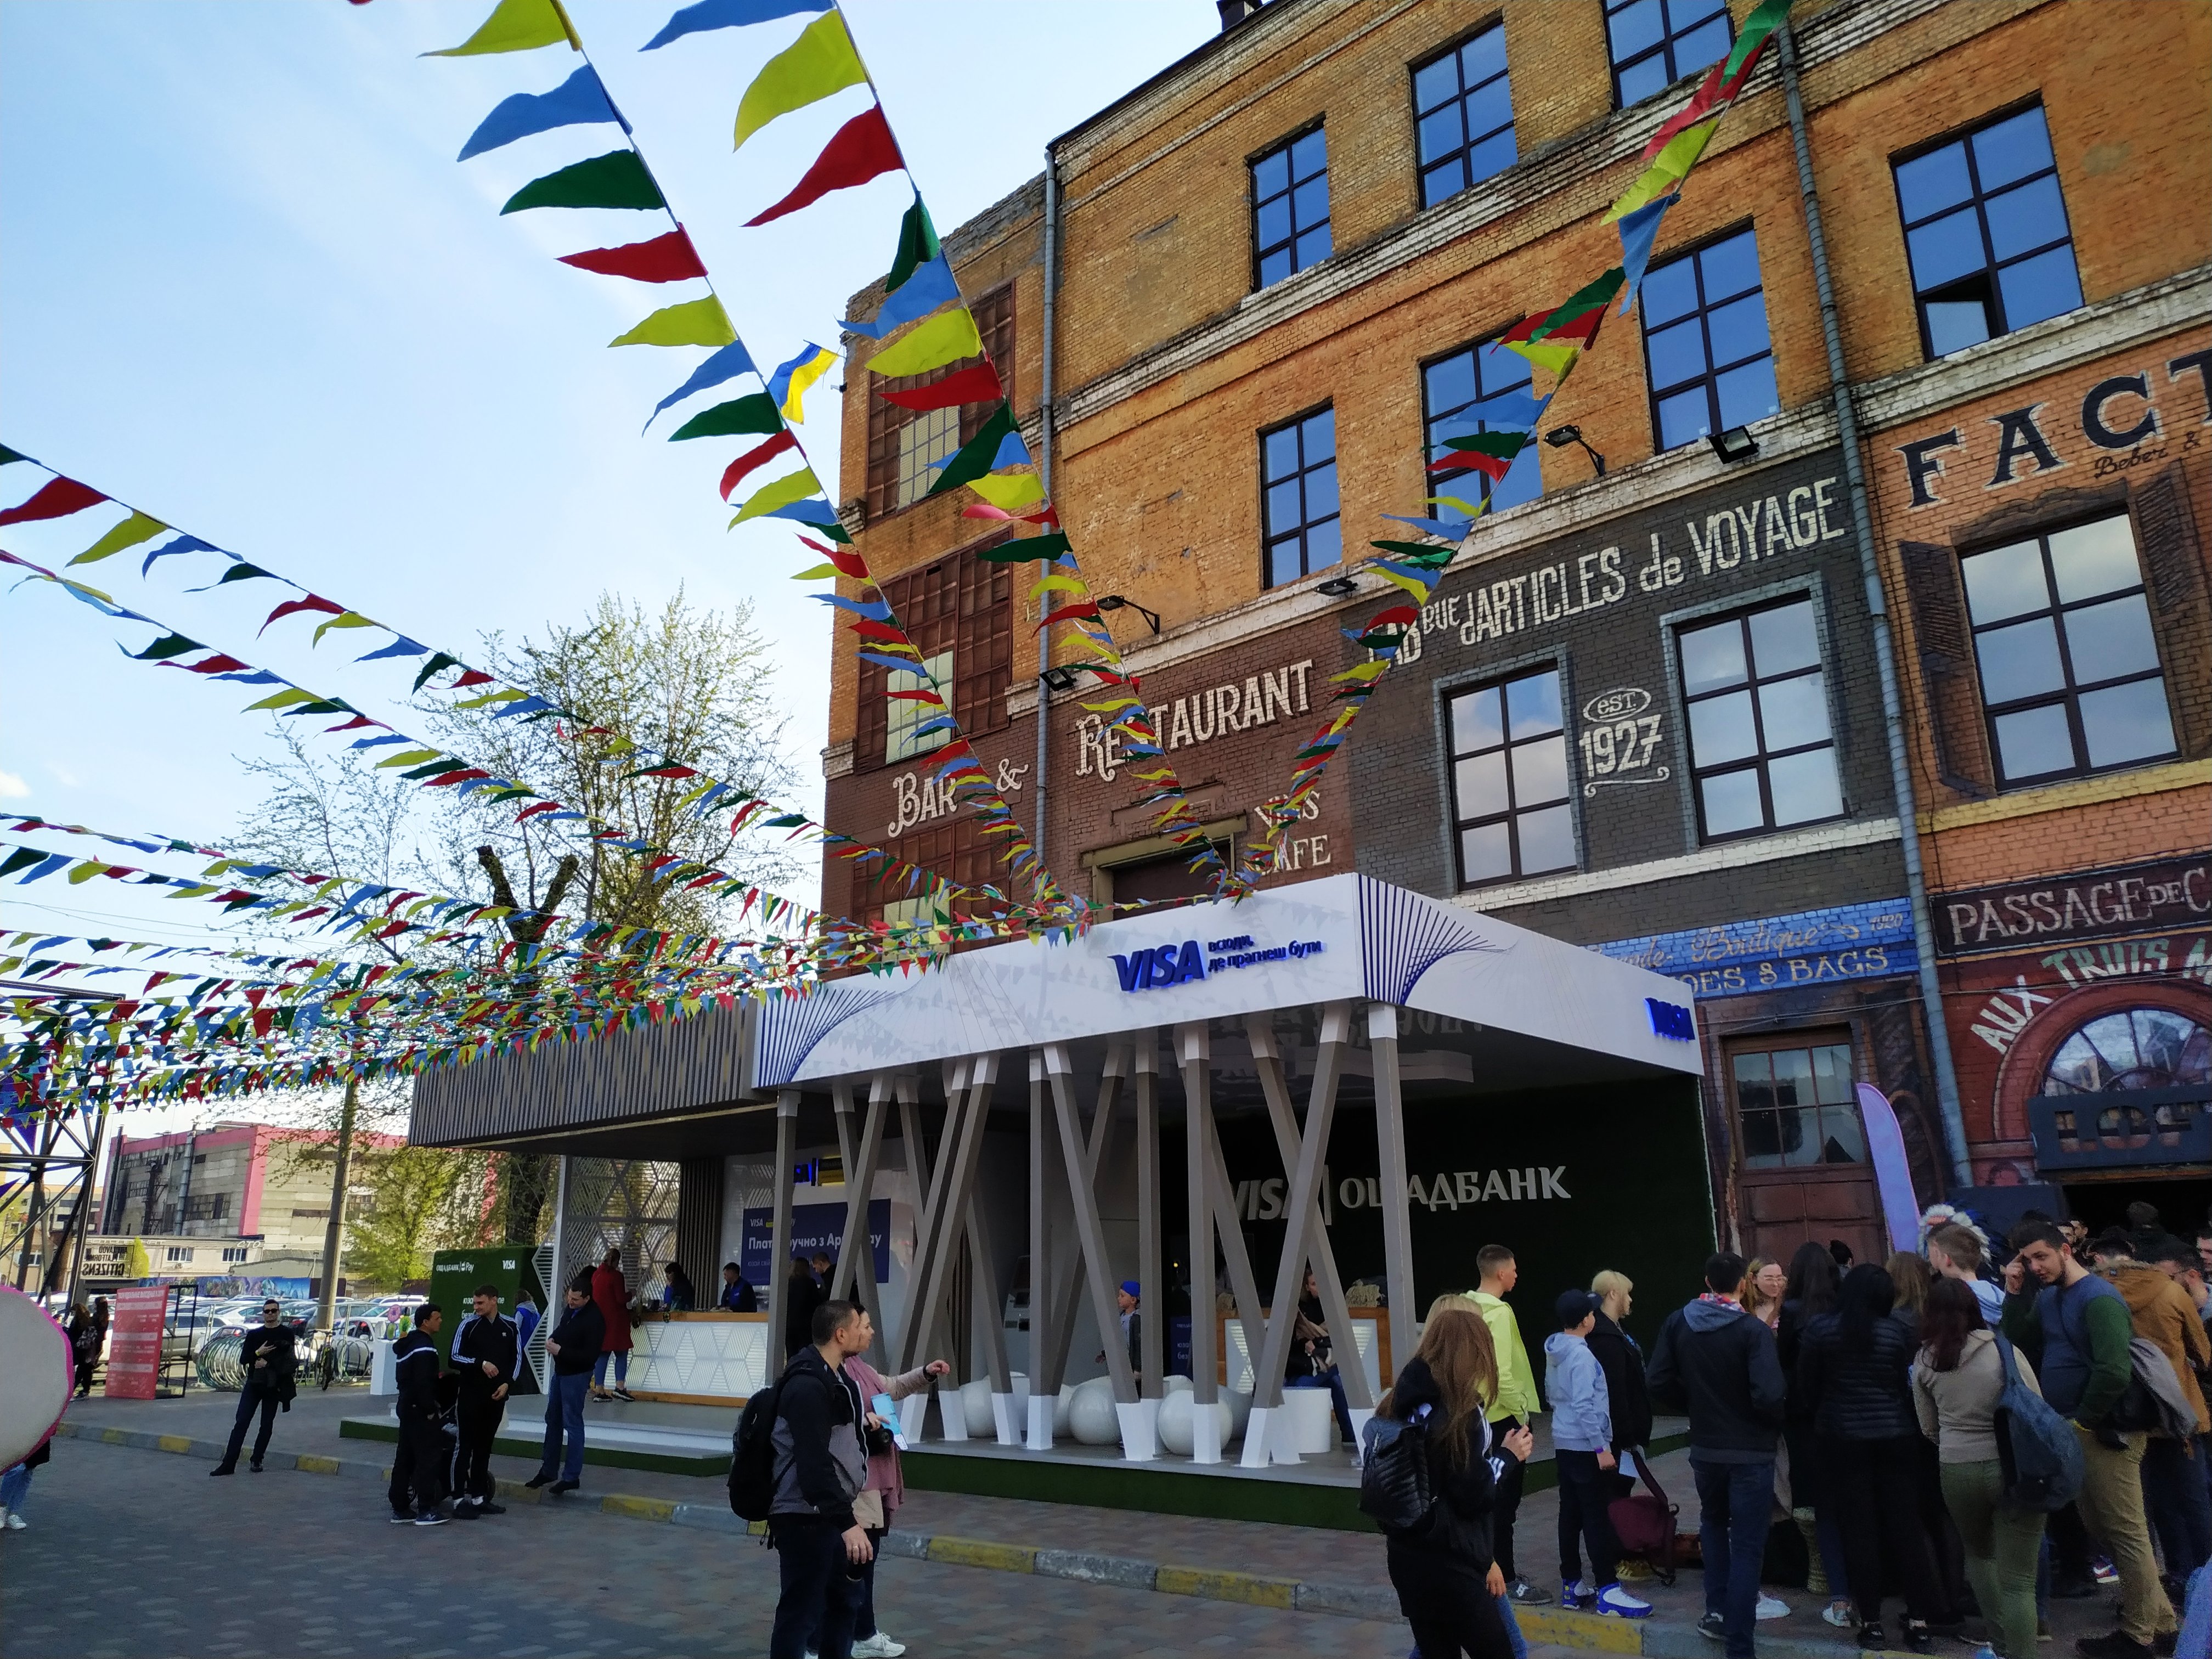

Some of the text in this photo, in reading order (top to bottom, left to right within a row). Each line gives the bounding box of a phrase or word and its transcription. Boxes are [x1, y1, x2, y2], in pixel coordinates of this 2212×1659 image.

[1893, 348, 2212, 511] FACT
[1640, 533, 1684, 592] de
[1686, 477, 1845, 576] VOYAGE
[1578, 714, 1663, 777] 1927
[996, 759, 1029, 792] &
[1256, 834, 1331, 876] AFE
[1946, 877, 2152, 945] PASSAGE
[2146, 882, 2185, 905] DE
[1208, 957, 1226, 972] де
[1289, 940, 1323, 958] бути
[1691, 922, 1860, 962] Boutique
[1108, 940, 1205, 991] VISA
[1673, 967, 1745, 993] OES
[1787, 947, 1888, 981] BAGS
[1970, 975, 2053, 1054] AUX
[1230, 1178, 1293, 1220] VIS
[750, 1218, 763, 1227] VISA
[503, 1260, 516, 1269] VISA
[748, 1237, 773, 1250] Плат
[790, 1237, 816, 1252] учно
[466, 1262, 475, 1273] Pay
